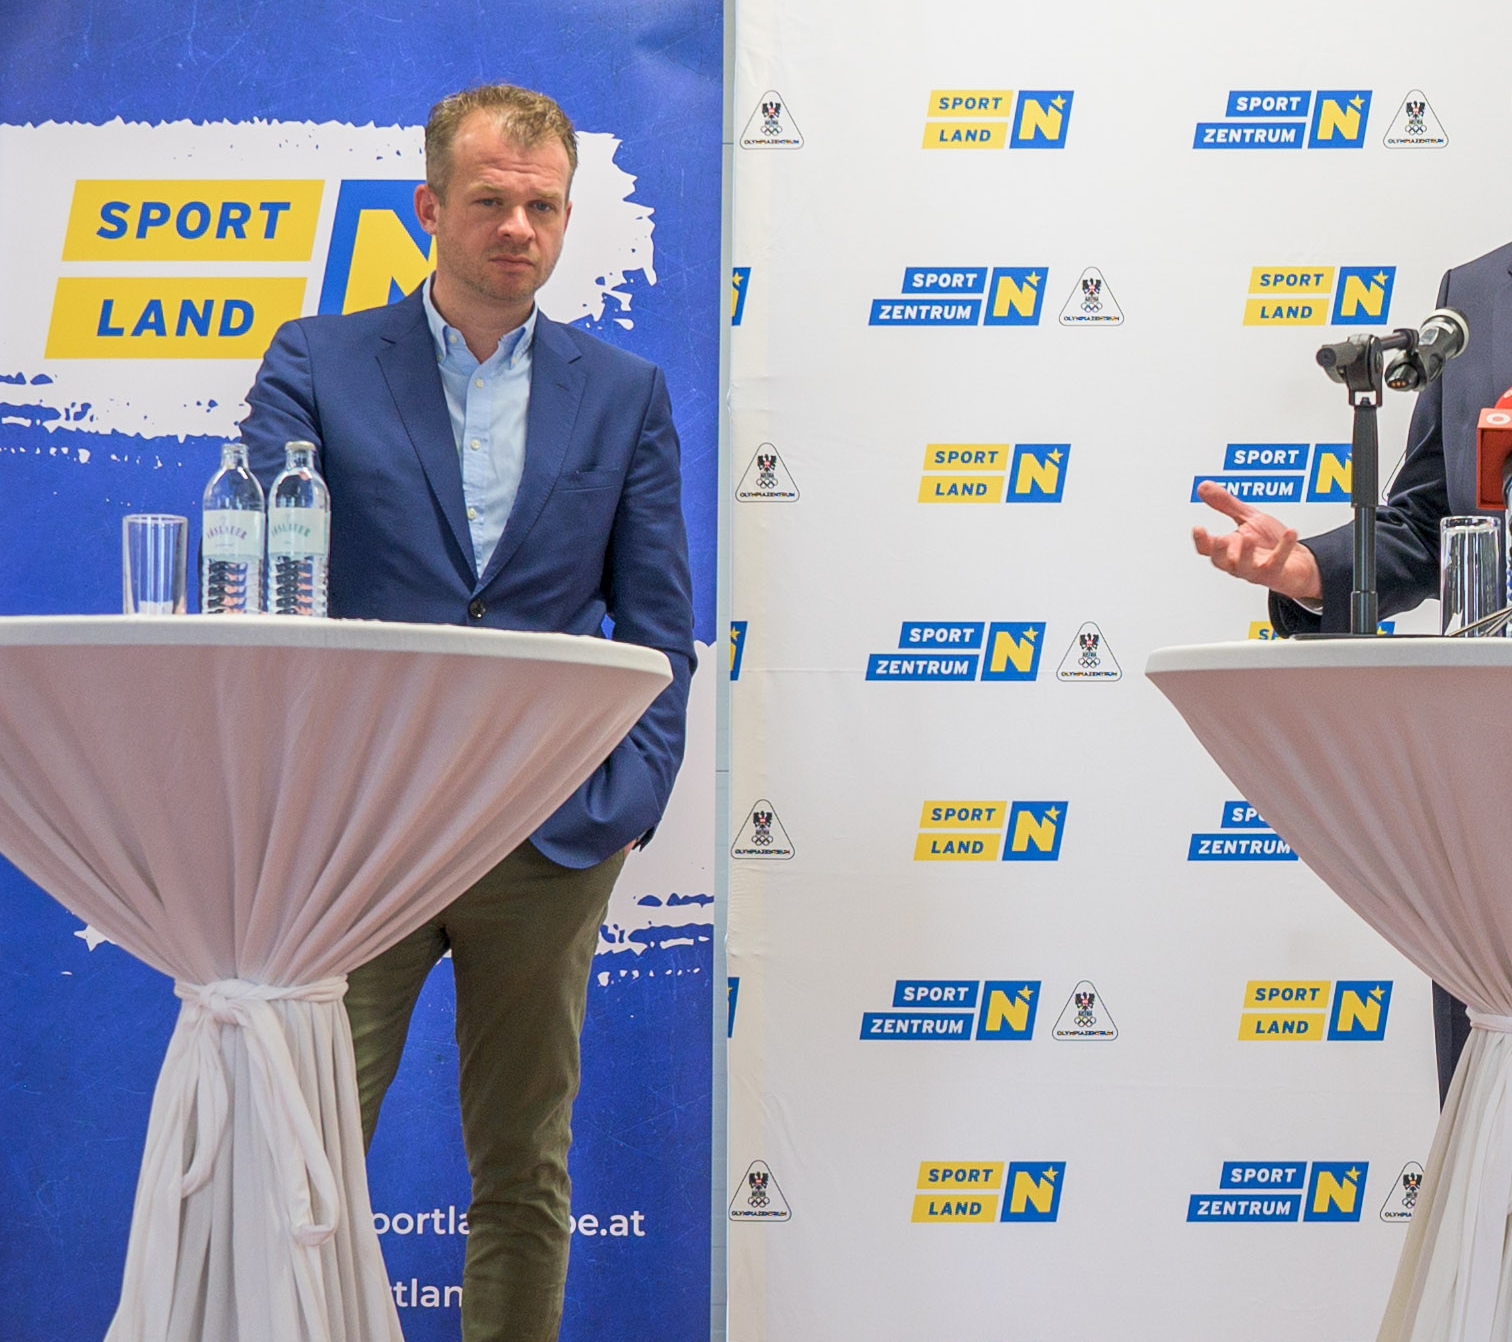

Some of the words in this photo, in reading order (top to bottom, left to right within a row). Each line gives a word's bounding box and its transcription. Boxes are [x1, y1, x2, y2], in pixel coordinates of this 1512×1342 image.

[938, 96, 1002, 111] SPORT
[1235, 96, 1302, 112] SPORT
[938, 128, 992, 143] LAND
[1202, 128, 1297, 144] ZENTRUM
[96, 201, 292, 240] SPORT
[912, 272, 978, 288] SPORT
[1260, 272, 1324, 287] SPORT
[96, 299, 255, 337] LAND
[878, 304, 972, 320] ZENTRUM
[1259, 305, 1313, 319] LAND
[935, 450, 999, 464] SPORT
[1233, 449, 1300, 465] SPORT
[935, 482, 988, 496] LAND
[1219, 481, 1294, 496] NTRUM
[909, 627, 975, 643] SPORT
[875, 660, 970, 675] ZENTRUM
[931, 807, 996, 822] SPORT
[931, 840, 984, 855] LAND
[1198, 839, 1291, 855] ZENTRUM
[903, 986, 969, 1002] SPORT
[1255, 987, 1321, 1002] SPORT
[870, 1018, 964, 1034] ZENTRUM
[1255, 1020, 1309, 1034] LAND
[928, 1168, 994, 1183] SPORT
[1230, 1167, 1297, 1183] SPORT
[928, 1201, 982, 1216] LAND
[1197, 1200, 1292, 1216] ZENTRUM
